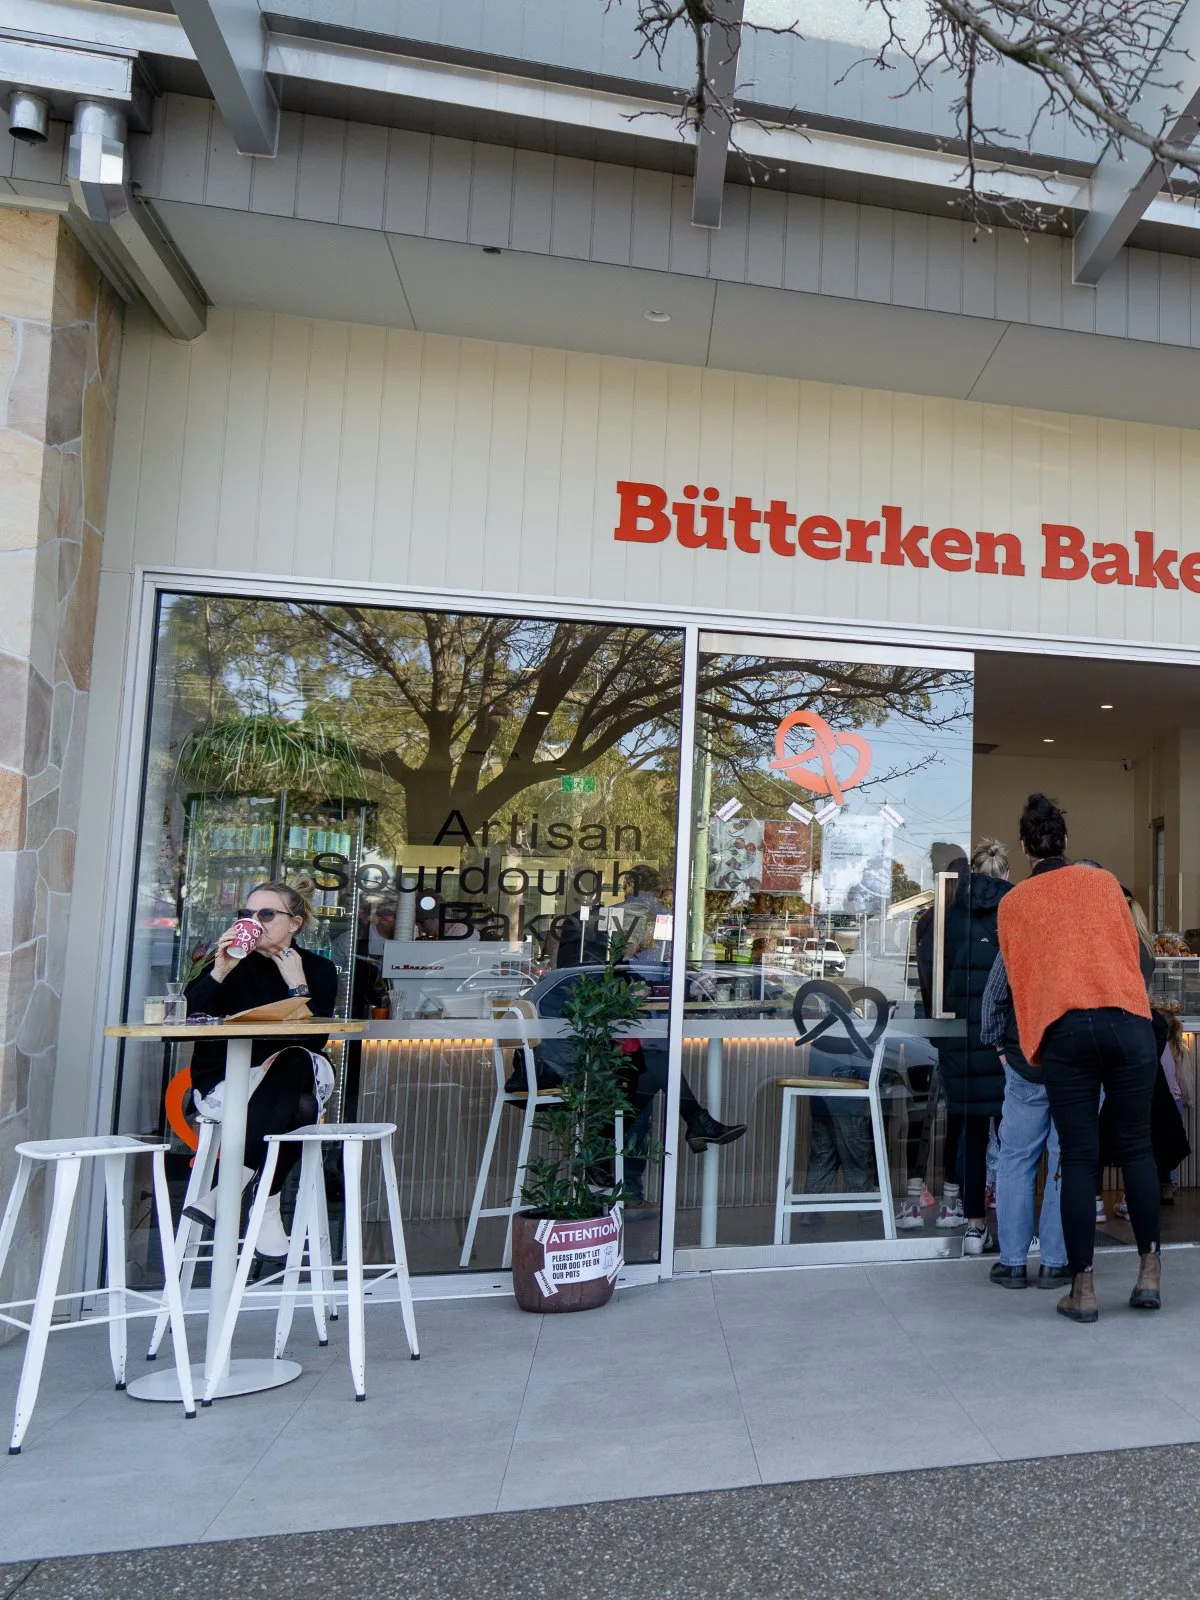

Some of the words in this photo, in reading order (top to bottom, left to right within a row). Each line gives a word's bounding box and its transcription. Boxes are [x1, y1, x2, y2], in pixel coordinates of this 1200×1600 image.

[614, 480, 1026, 577] Bütterken
[432, 809, 642, 851] Artisan
[312, 851, 641, 906] Sourdough
[438, 902, 642, 946] Bakery
[549, 1222, 617, 1244] ATTENTION
[552, 1253, 573, 1262] PLEASE
[574, 1250, 591, 1259] DON'T
[592, 1248, 600, 1258] LET
[552, 1262, 568, 1271] YOUR
[569, 1261, 581, 1269] DOG
[582, 1259, 592, 1268] PEE
[593, 1257, 600, 1266] ON
[552, 1271, 564, 1280] OUR
[565, 1270, 580, 1279] POTS
